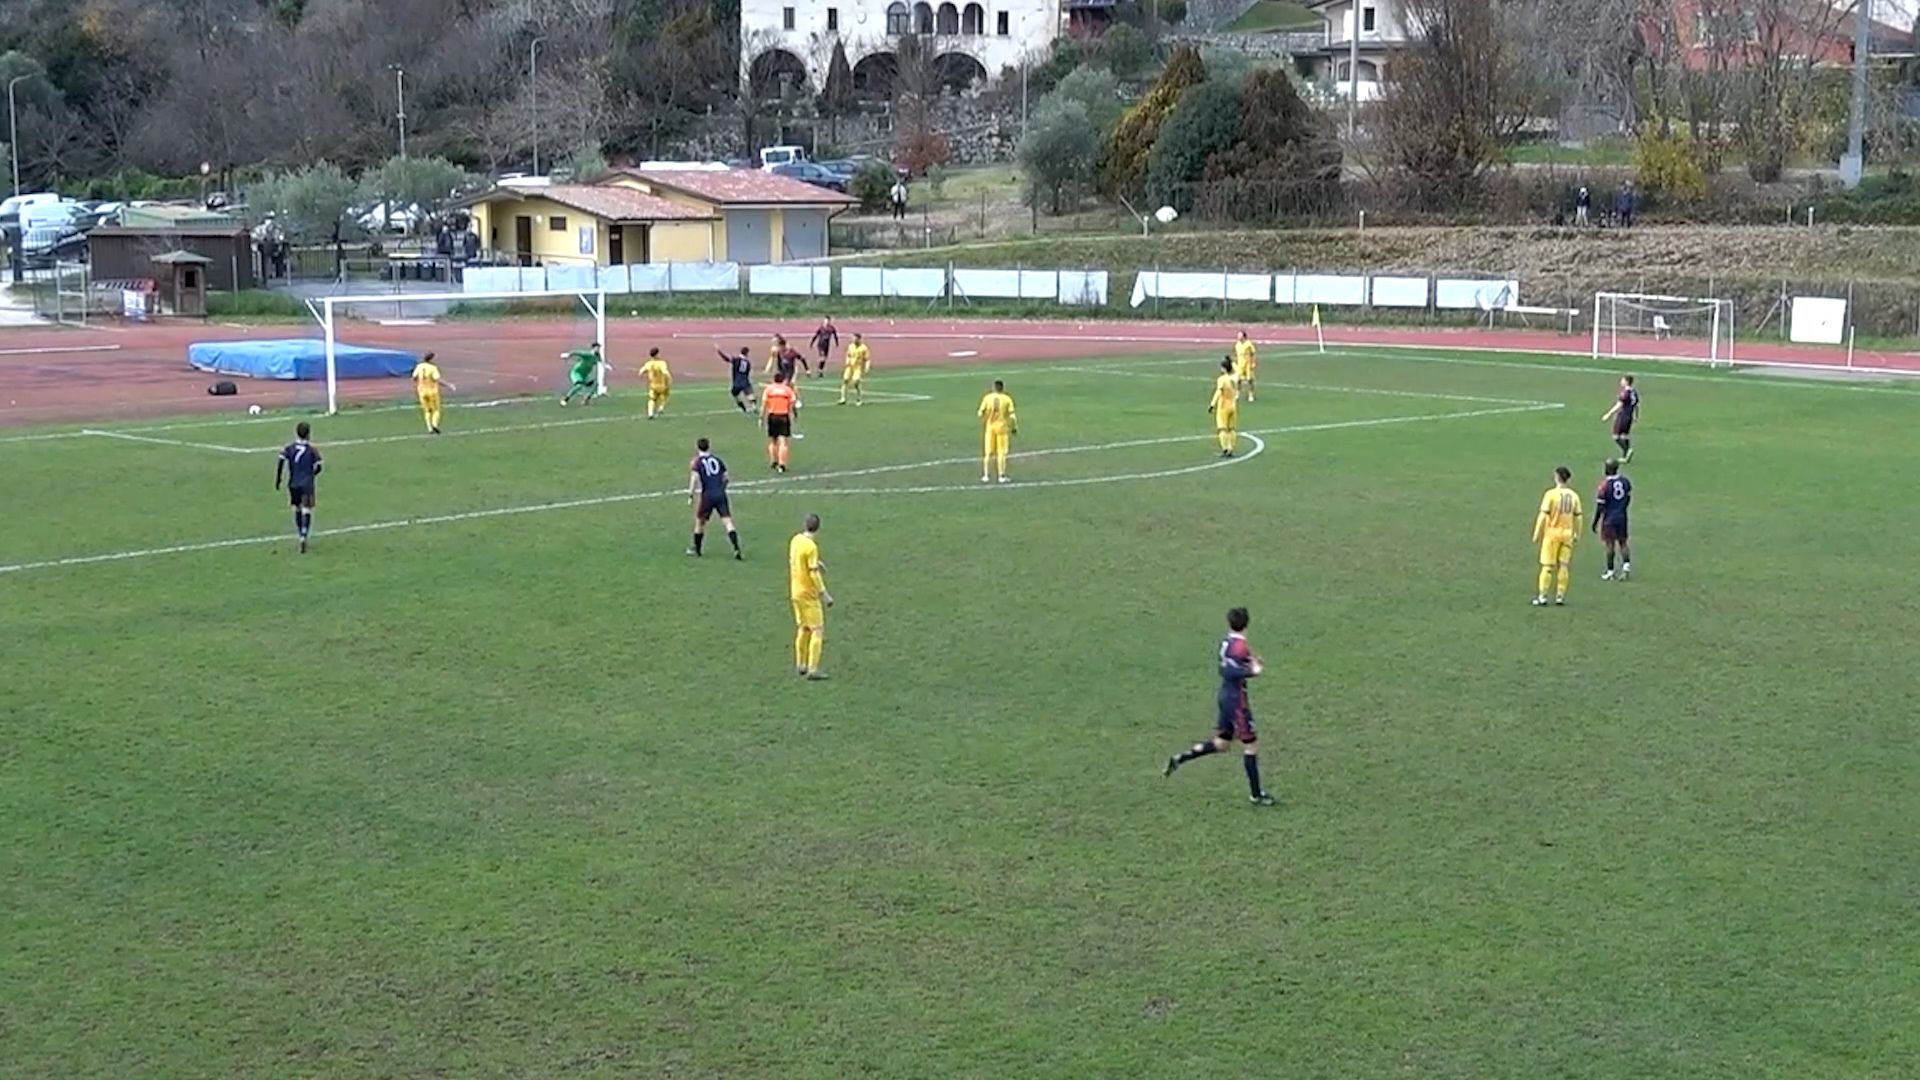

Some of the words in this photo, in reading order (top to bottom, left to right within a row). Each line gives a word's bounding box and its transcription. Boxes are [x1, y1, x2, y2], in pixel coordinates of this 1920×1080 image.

[294, 445, 307, 463] 7
[701, 456, 720, 477] 10
[1612, 480, 1625, 500] 8
